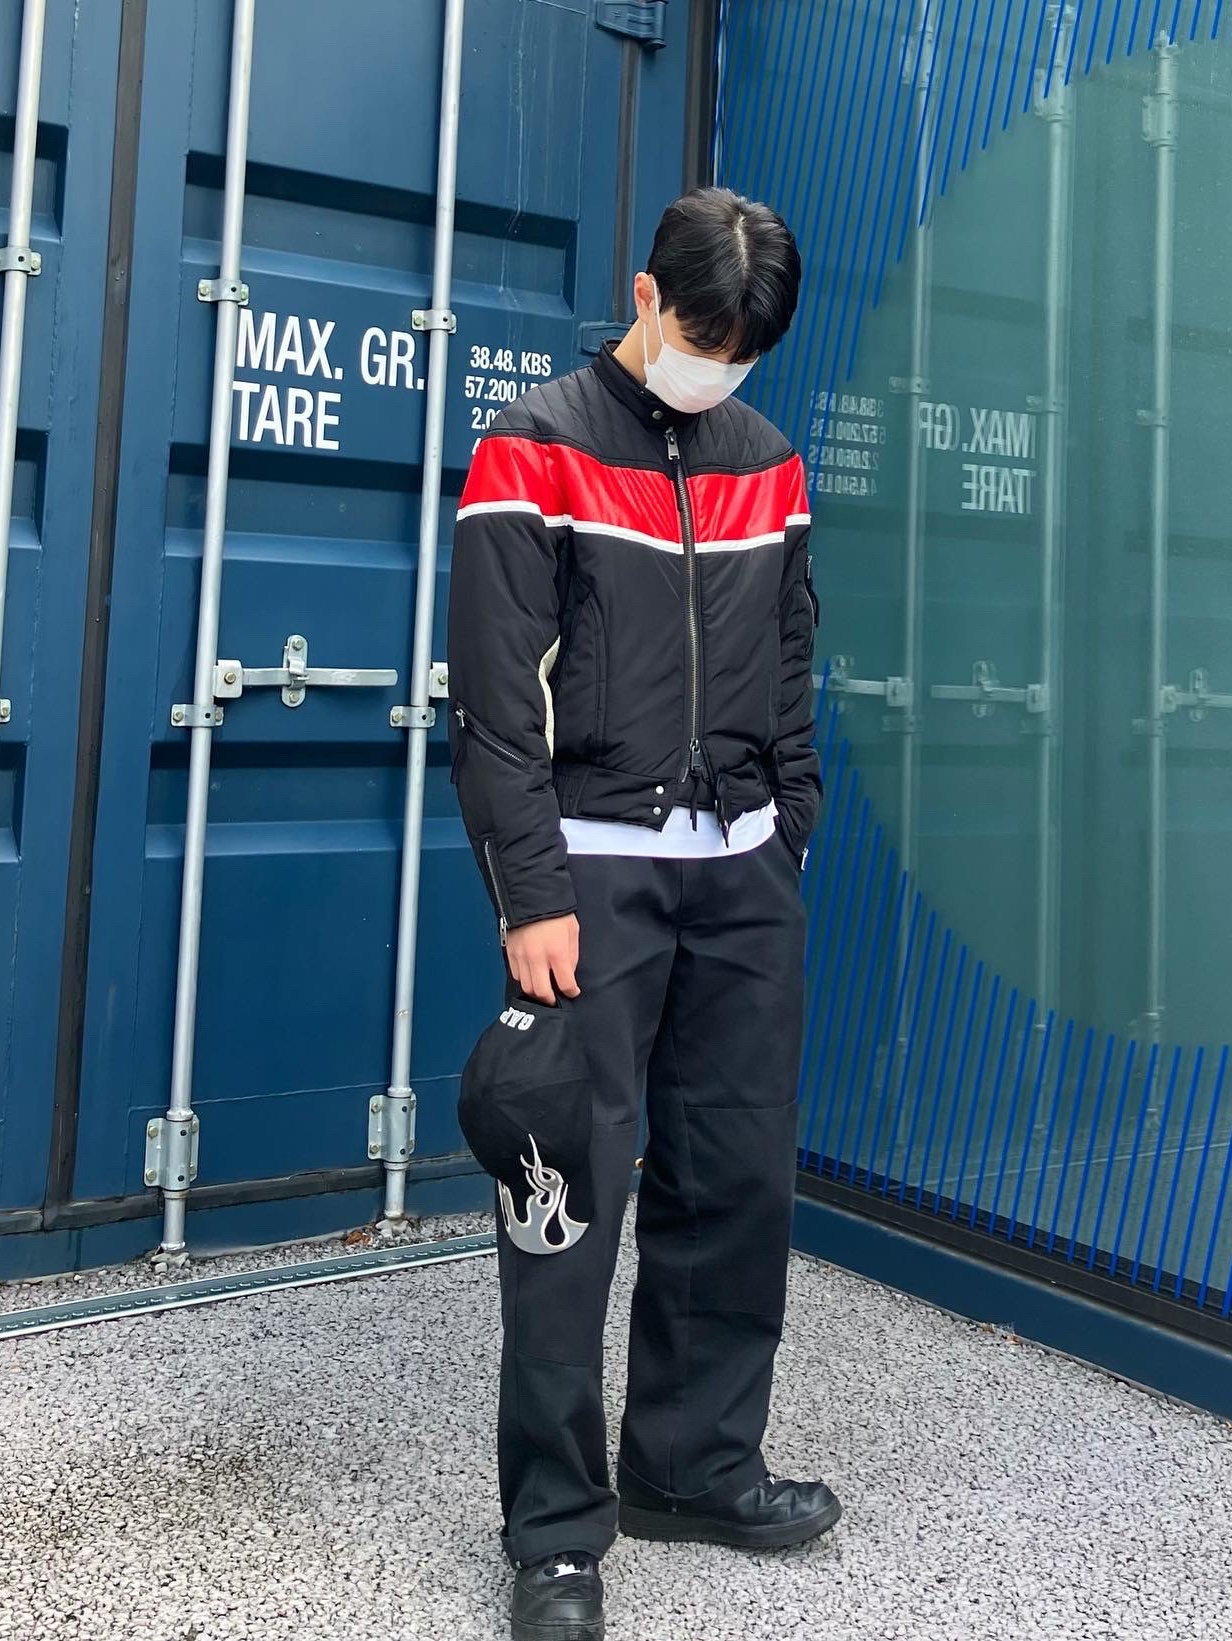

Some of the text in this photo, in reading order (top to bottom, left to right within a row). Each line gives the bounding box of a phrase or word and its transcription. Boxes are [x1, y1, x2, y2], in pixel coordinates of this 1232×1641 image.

[236, 308, 426, 391] MAX. GR.
[470, 345, 552, 377] 38.48. KBS
[464, 375, 518, 403] 57.200
[232, 380, 341, 450] TARE
